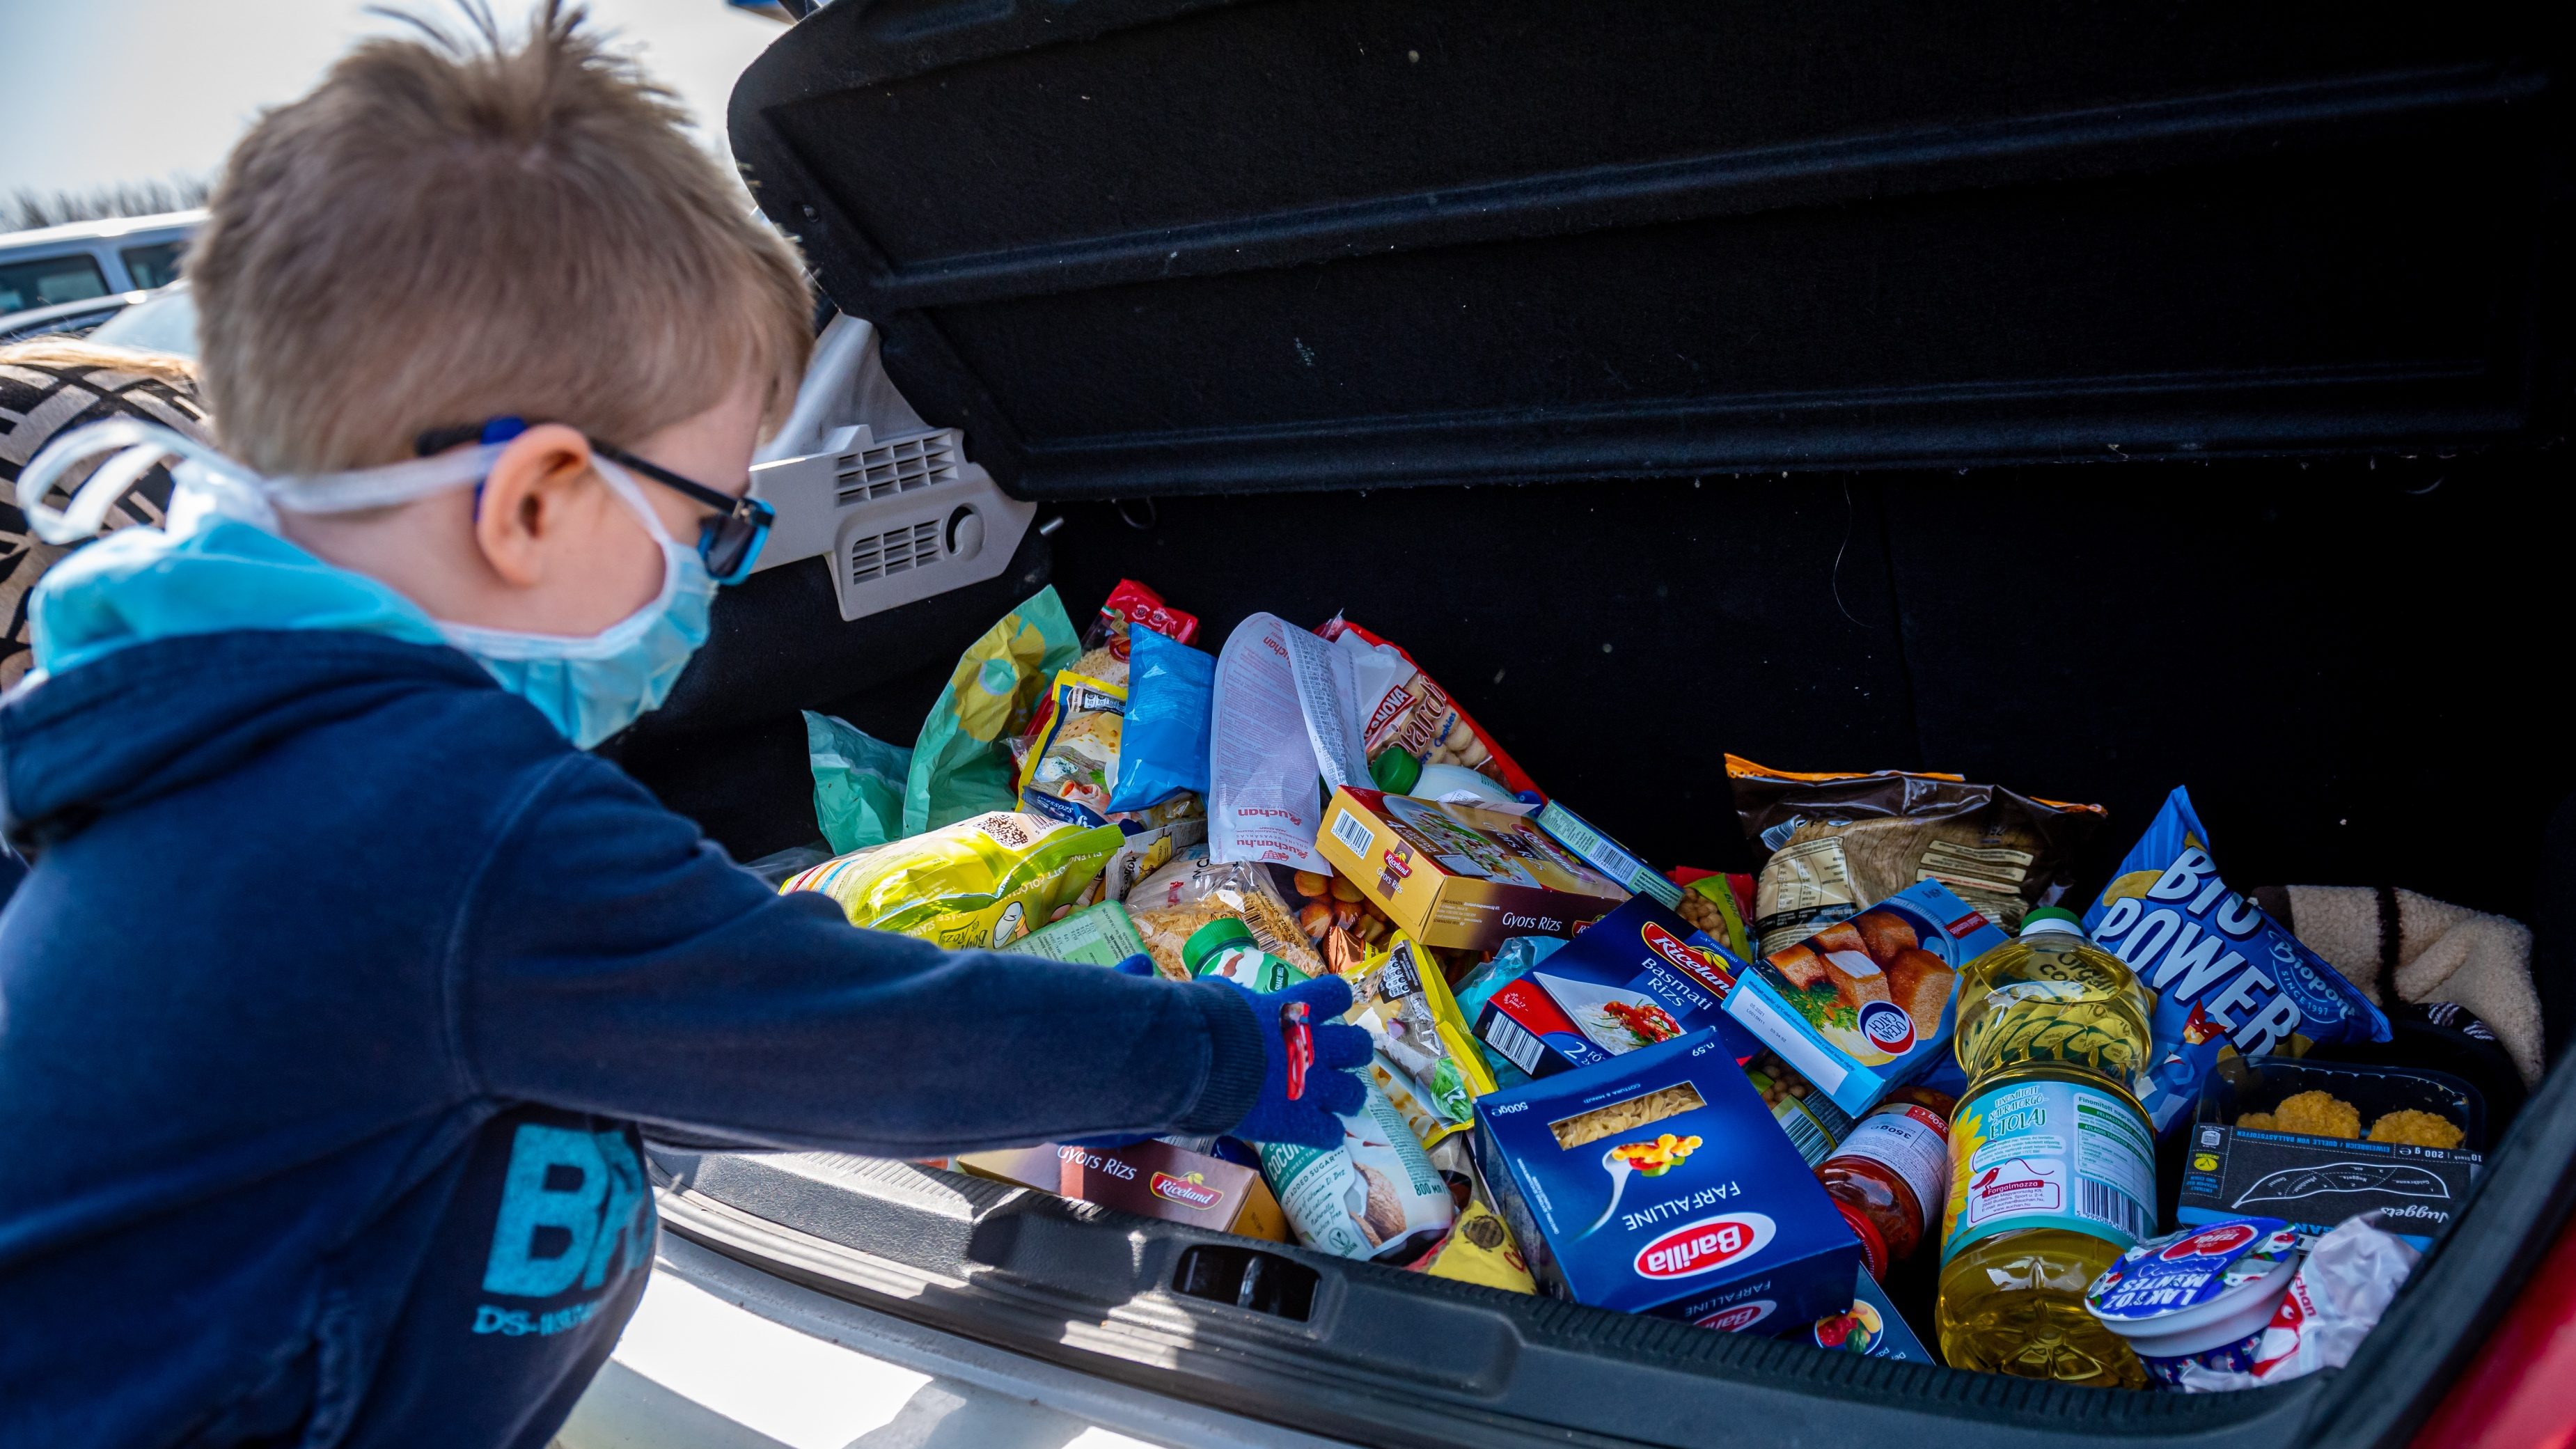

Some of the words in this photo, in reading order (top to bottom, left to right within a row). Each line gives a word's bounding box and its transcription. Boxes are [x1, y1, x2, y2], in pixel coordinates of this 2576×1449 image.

[1236, 840, 1308, 859] Auchan.hu
[1385, 853, 1410, 876] Riceland
[1376, 867, 1392, 886] Gyors
[1391, 877, 1404, 895] Rizs
[1502, 912, 1535, 930] Gyors
[1537, 916, 1562, 932] Rizs
[1641, 958, 1714, 1010] Basmati
[2091, 897, 2302, 1056] POWER
[1647, 979, 1686, 1008] Rizs
[2282, 970, 2306, 1007] SINCE
[2307, 1001, 2329, 1017] 1997
[1868, 1012, 1897, 1033] CATCH
[1883, 1021, 1907, 1042] OCEAN
[1564, 1042, 1587, 1060] 2
[1692, 1042, 1715, 1058] n.59
[1612, 1083, 1641, 1096] COTTURA
[1994, 1086, 2040, 1108] FINOMÍTOTT
[2078, 1096, 2113, 1112] Finomított
[1879, 1125, 1912, 1140] 350g
[1989, 1108, 2045, 1139] ÉTOLAJ
[2084, 1125, 2105, 1136] ÁTLAGOS
[2236, 1130, 2294, 1142] BALLASTSTOFFEN
[2312, 1138, 2337, 1147] QUELLE
[1056, 1144, 1102, 1170] Gyors
[1102, 1158, 1137, 1181] Rizs
[2425, 1150, 2444, 1158] 200
[2471, 1153, 2482, 1162] 10
[1289, 1159, 1305, 1174] SWEET
[1157, 1180, 1214, 1205] Riceland
[1290, 1175, 1309, 1199] ADDED
[1307, 1185, 1325, 1202] vitamin
[1415, 1183, 1431, 1197] 800
[1987, 1180, 2039, 1196] Forgalmazza
[1312, 1192, 1333, 1211] calcium
[1621, 1180, 1742, 1231] FARFALLINE
[1983, 1194, 2000, 1203] Auchan
[1993, 1203, 2031, 1213] www.auchan.hu
[2085, 1212, 2114, 1228] 999086
[2295, 1222, 2336, 1235] GAN
[1647, 1225, 1742, 1273] Barilla
[2122, 1274, 2212, 1292] MENTES
[1684, 1280, 1771, 1317] FARFALLINE
[2295, 1271, 2317, 1317] chan
